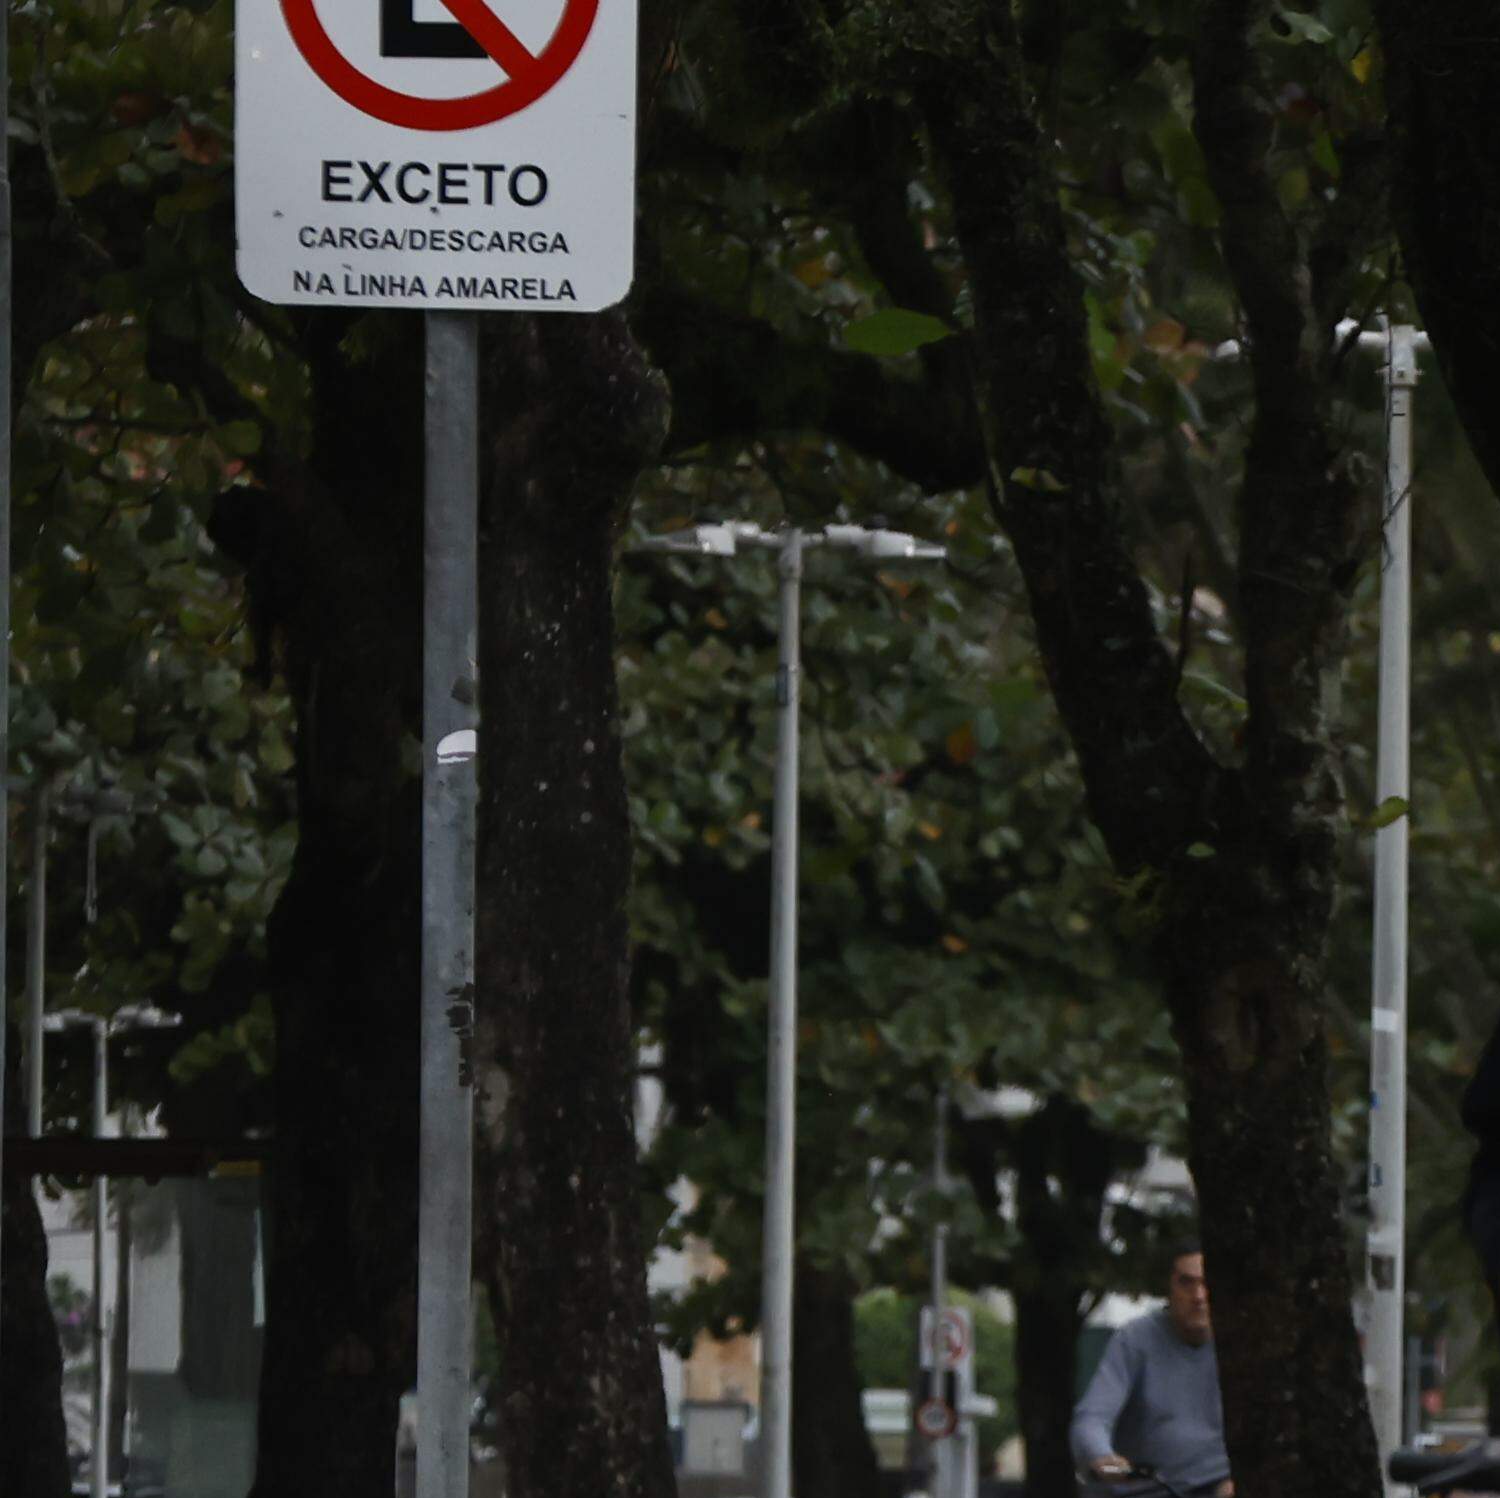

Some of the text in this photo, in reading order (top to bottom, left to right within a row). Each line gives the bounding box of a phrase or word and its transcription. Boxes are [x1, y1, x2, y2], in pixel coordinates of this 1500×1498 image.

[320, 159, 549, 207] EXCETO
[298, 226, 570, 255] CARGA/DESCARGA
[293, 270, 577, 301] NA LINHA AMARELA
